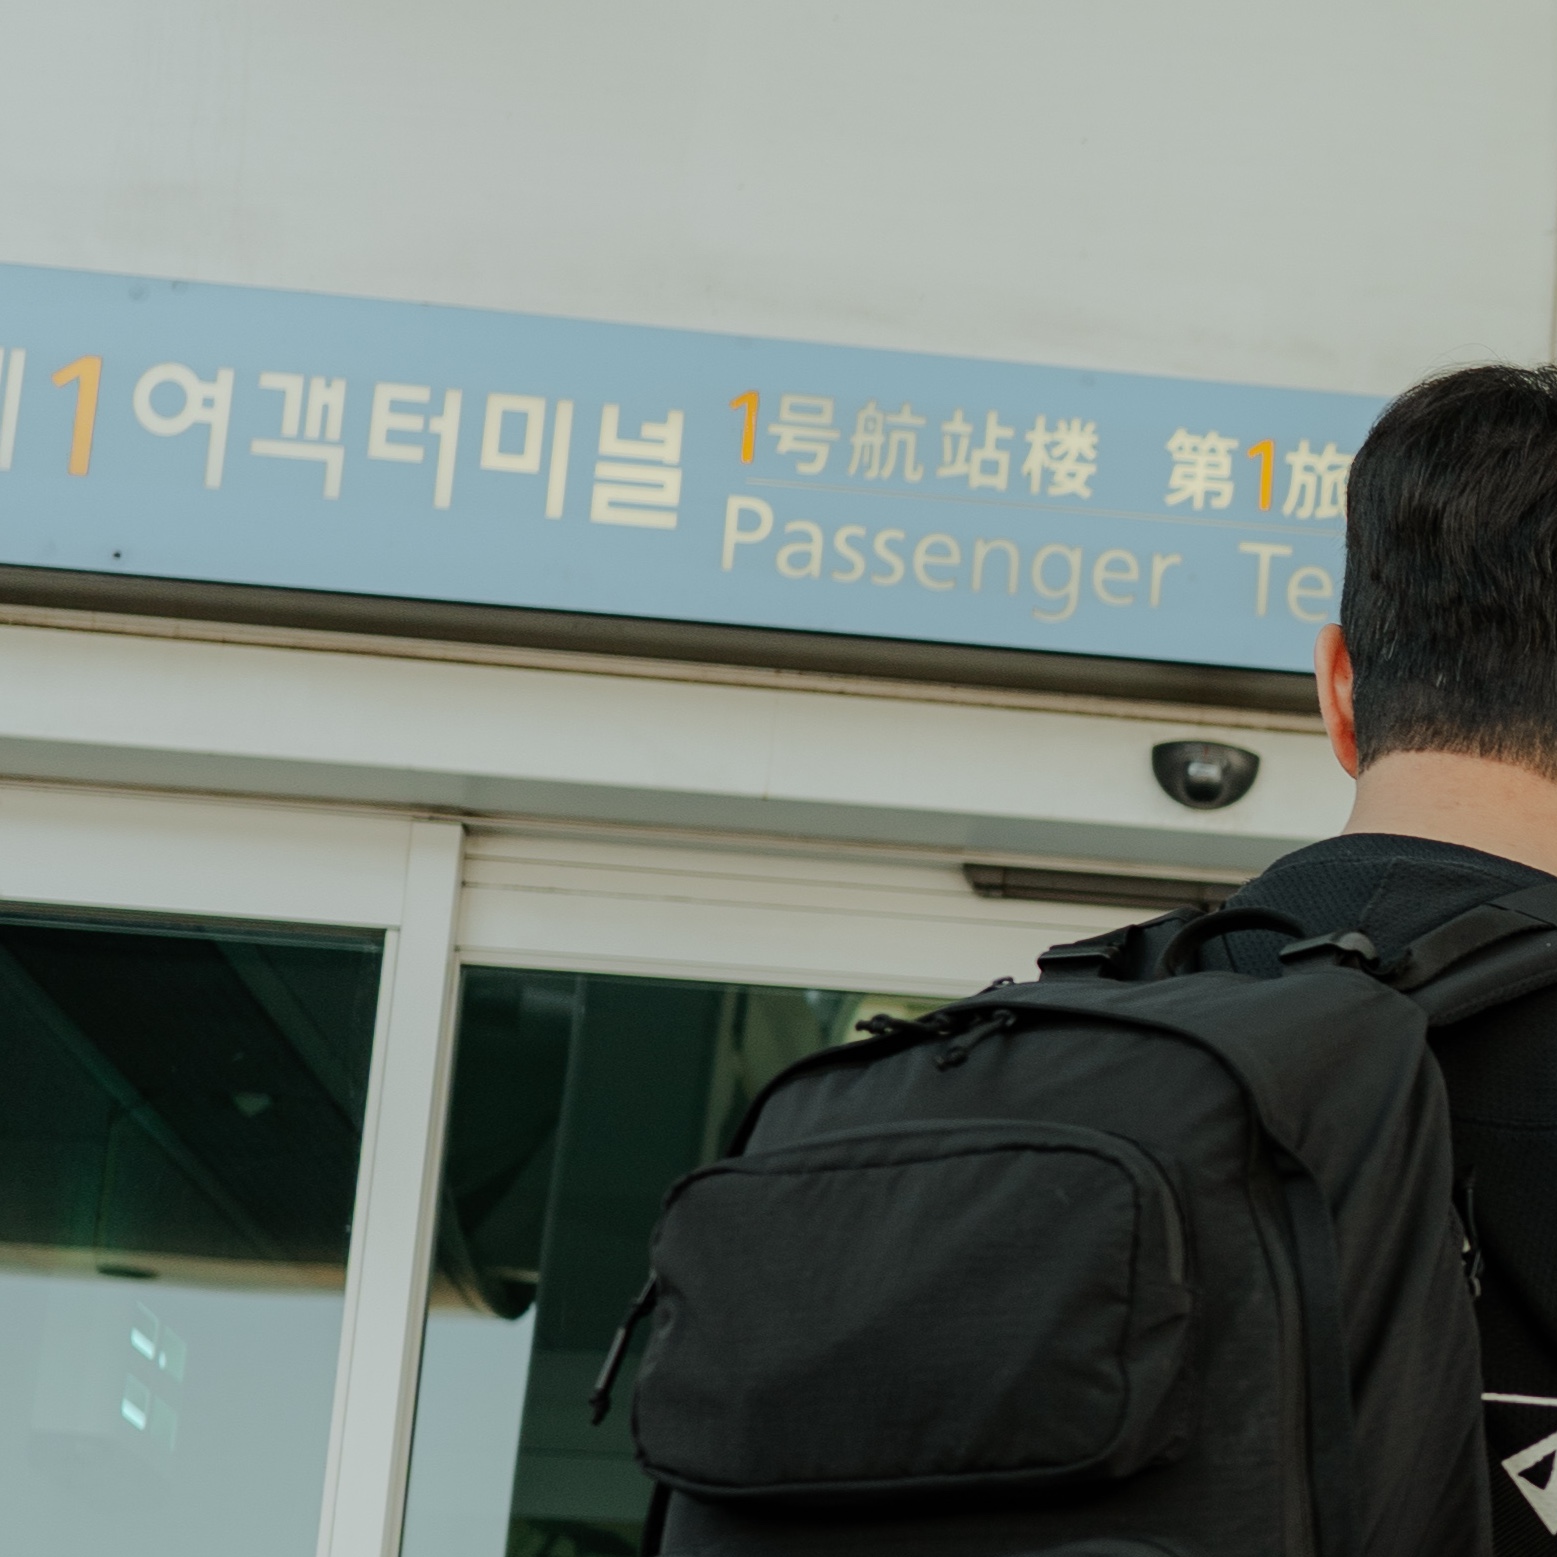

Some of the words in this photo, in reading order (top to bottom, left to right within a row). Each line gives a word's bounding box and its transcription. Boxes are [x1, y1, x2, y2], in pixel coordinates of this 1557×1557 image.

[729, 390, 1100, 502] 1号航站楼
[1164, 428, 1353, 521] 第1旅
[721, 495, 1182, 623] Passenger
[1238, 541, 1335, 624] Te
